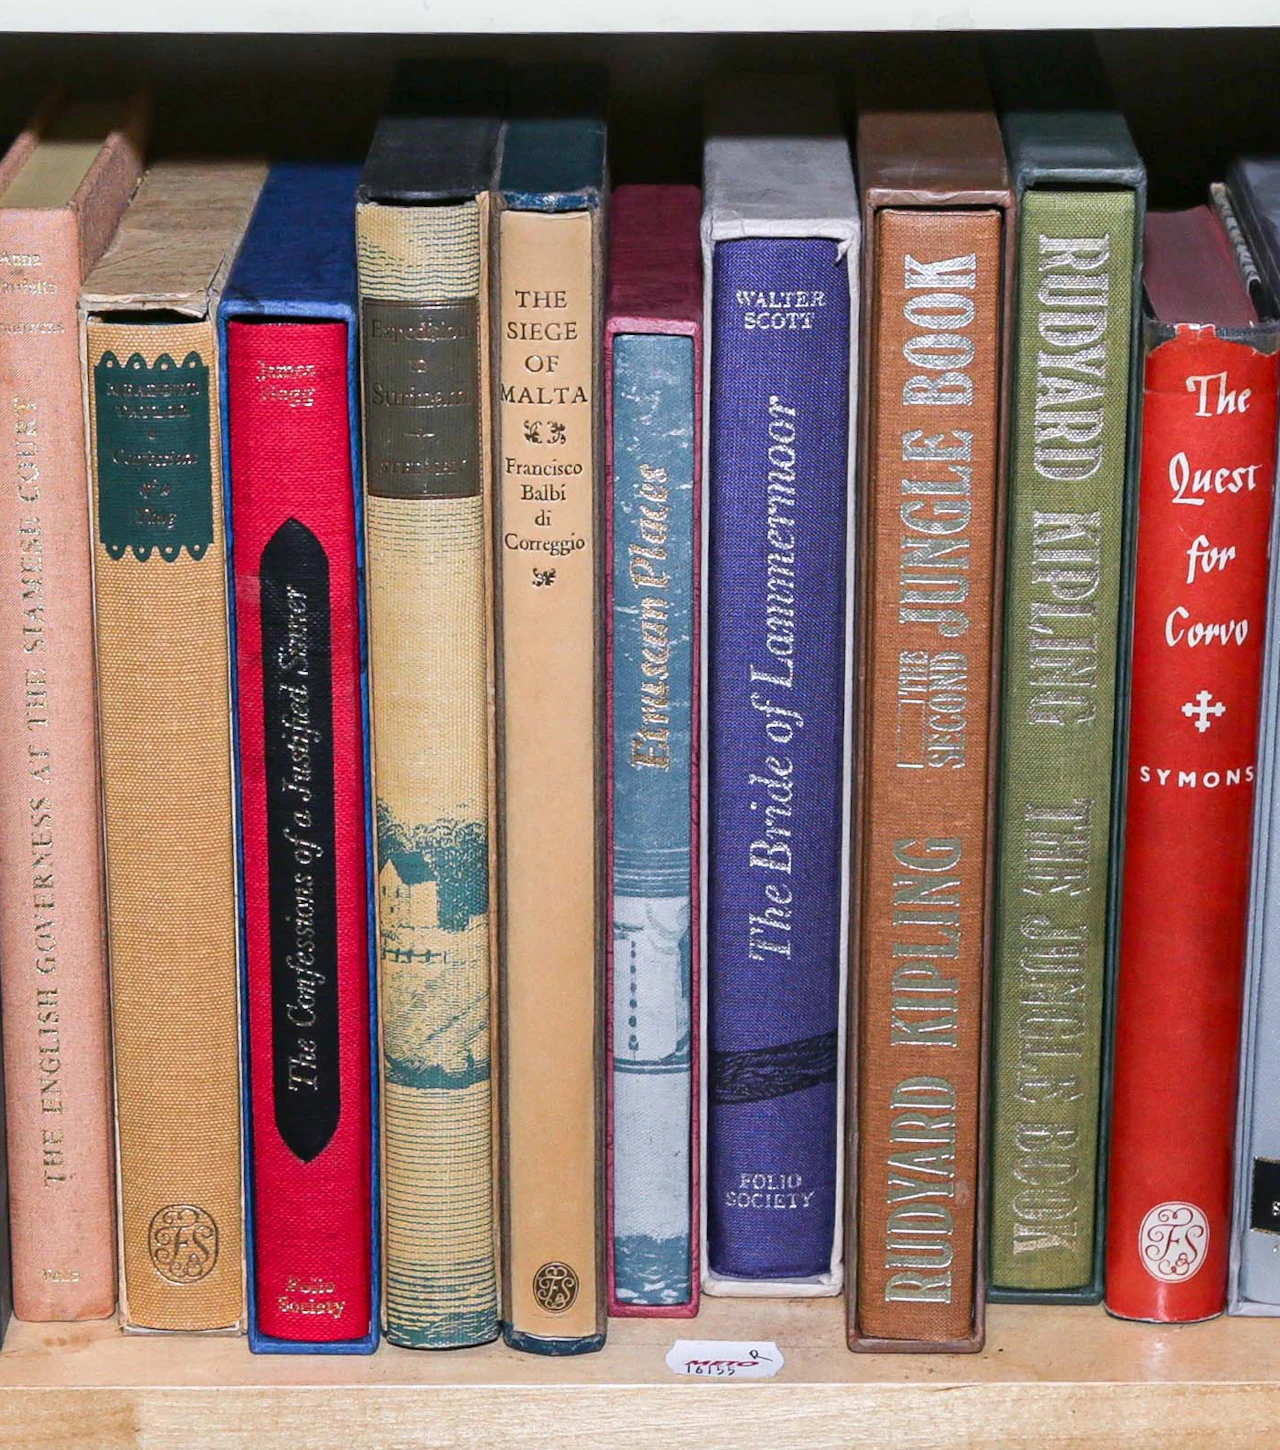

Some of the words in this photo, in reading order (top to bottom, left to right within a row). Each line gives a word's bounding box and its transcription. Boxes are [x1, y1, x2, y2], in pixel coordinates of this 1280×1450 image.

[514, 290, 568, 309] THE
[735, 289, 827, 309] WALTER
[744, 311, 816, 330] SCOTT
[506, 321, 578, 341] SIEGE
[902, 251, 977, 407] BOOK
[1033, 233, 1110, 481] RUDYARD
[524, 354, 560, 373] OF
[500, 385, 588, 404] MALTA
[1184, 371, 1252, 418] The
[13, 395, 41, 503] COURT
[504, 456, 583, 477] Francisco
[519, 484, 567, 501] Balbi
[1167, 451, 1263, 506] Quest
[504, 532, 585, 557] Correggio
[534, 509, 552, 527] di
[627, 462, 670, 590] Places
[750, 394, 797, 689] Lammermoor
[898, 429, 974, 638] JUNGLE
[19, 517, 48, 655] SIAMESE
[1186, 534, 1237, 585] for
[1027, 510, 1101, 726] KIPLING
[1163, 605, 1250, 648] Corvo
[22, 667, 50, 728] THE
[631, 597, 671, 773] Etruscan
[898, 649, 929, 697] THE
[750, 691, 804, 744] of
[928, 649, 969, 769] SECOND
[29, 743, 52, 785] AT
[280, 683, 322, 803] Justified
[1139, 764, 1255, 788] SYMONS
[294, 808, 312, 828] a
[748, 754, 794, 875] Bride
[283, 827, 324, 865] of
[1023, 797, 1095, 897] THE
[29, 795, 60, 976] GOVERNESS
[285, 872, 325, 1028] Confessions
[747, 882, 793, 962] The
[889, 835, 963, 1048] KIPLING
[1016, 914, 1090, 1104] JUNGLE
[37, 986, 63, 1114] ENGLISH
[287, 1038, 319, 1091] The
[44, 1128, 66, 1188] THE
[739, 1173, 803, 1190] FOLIO
[725, 1191, 815, 1208] SOCIETY
[884, 1074, 958, 1305] RUDYARD
[1012, 1121, 1080, 1256] BOOK
